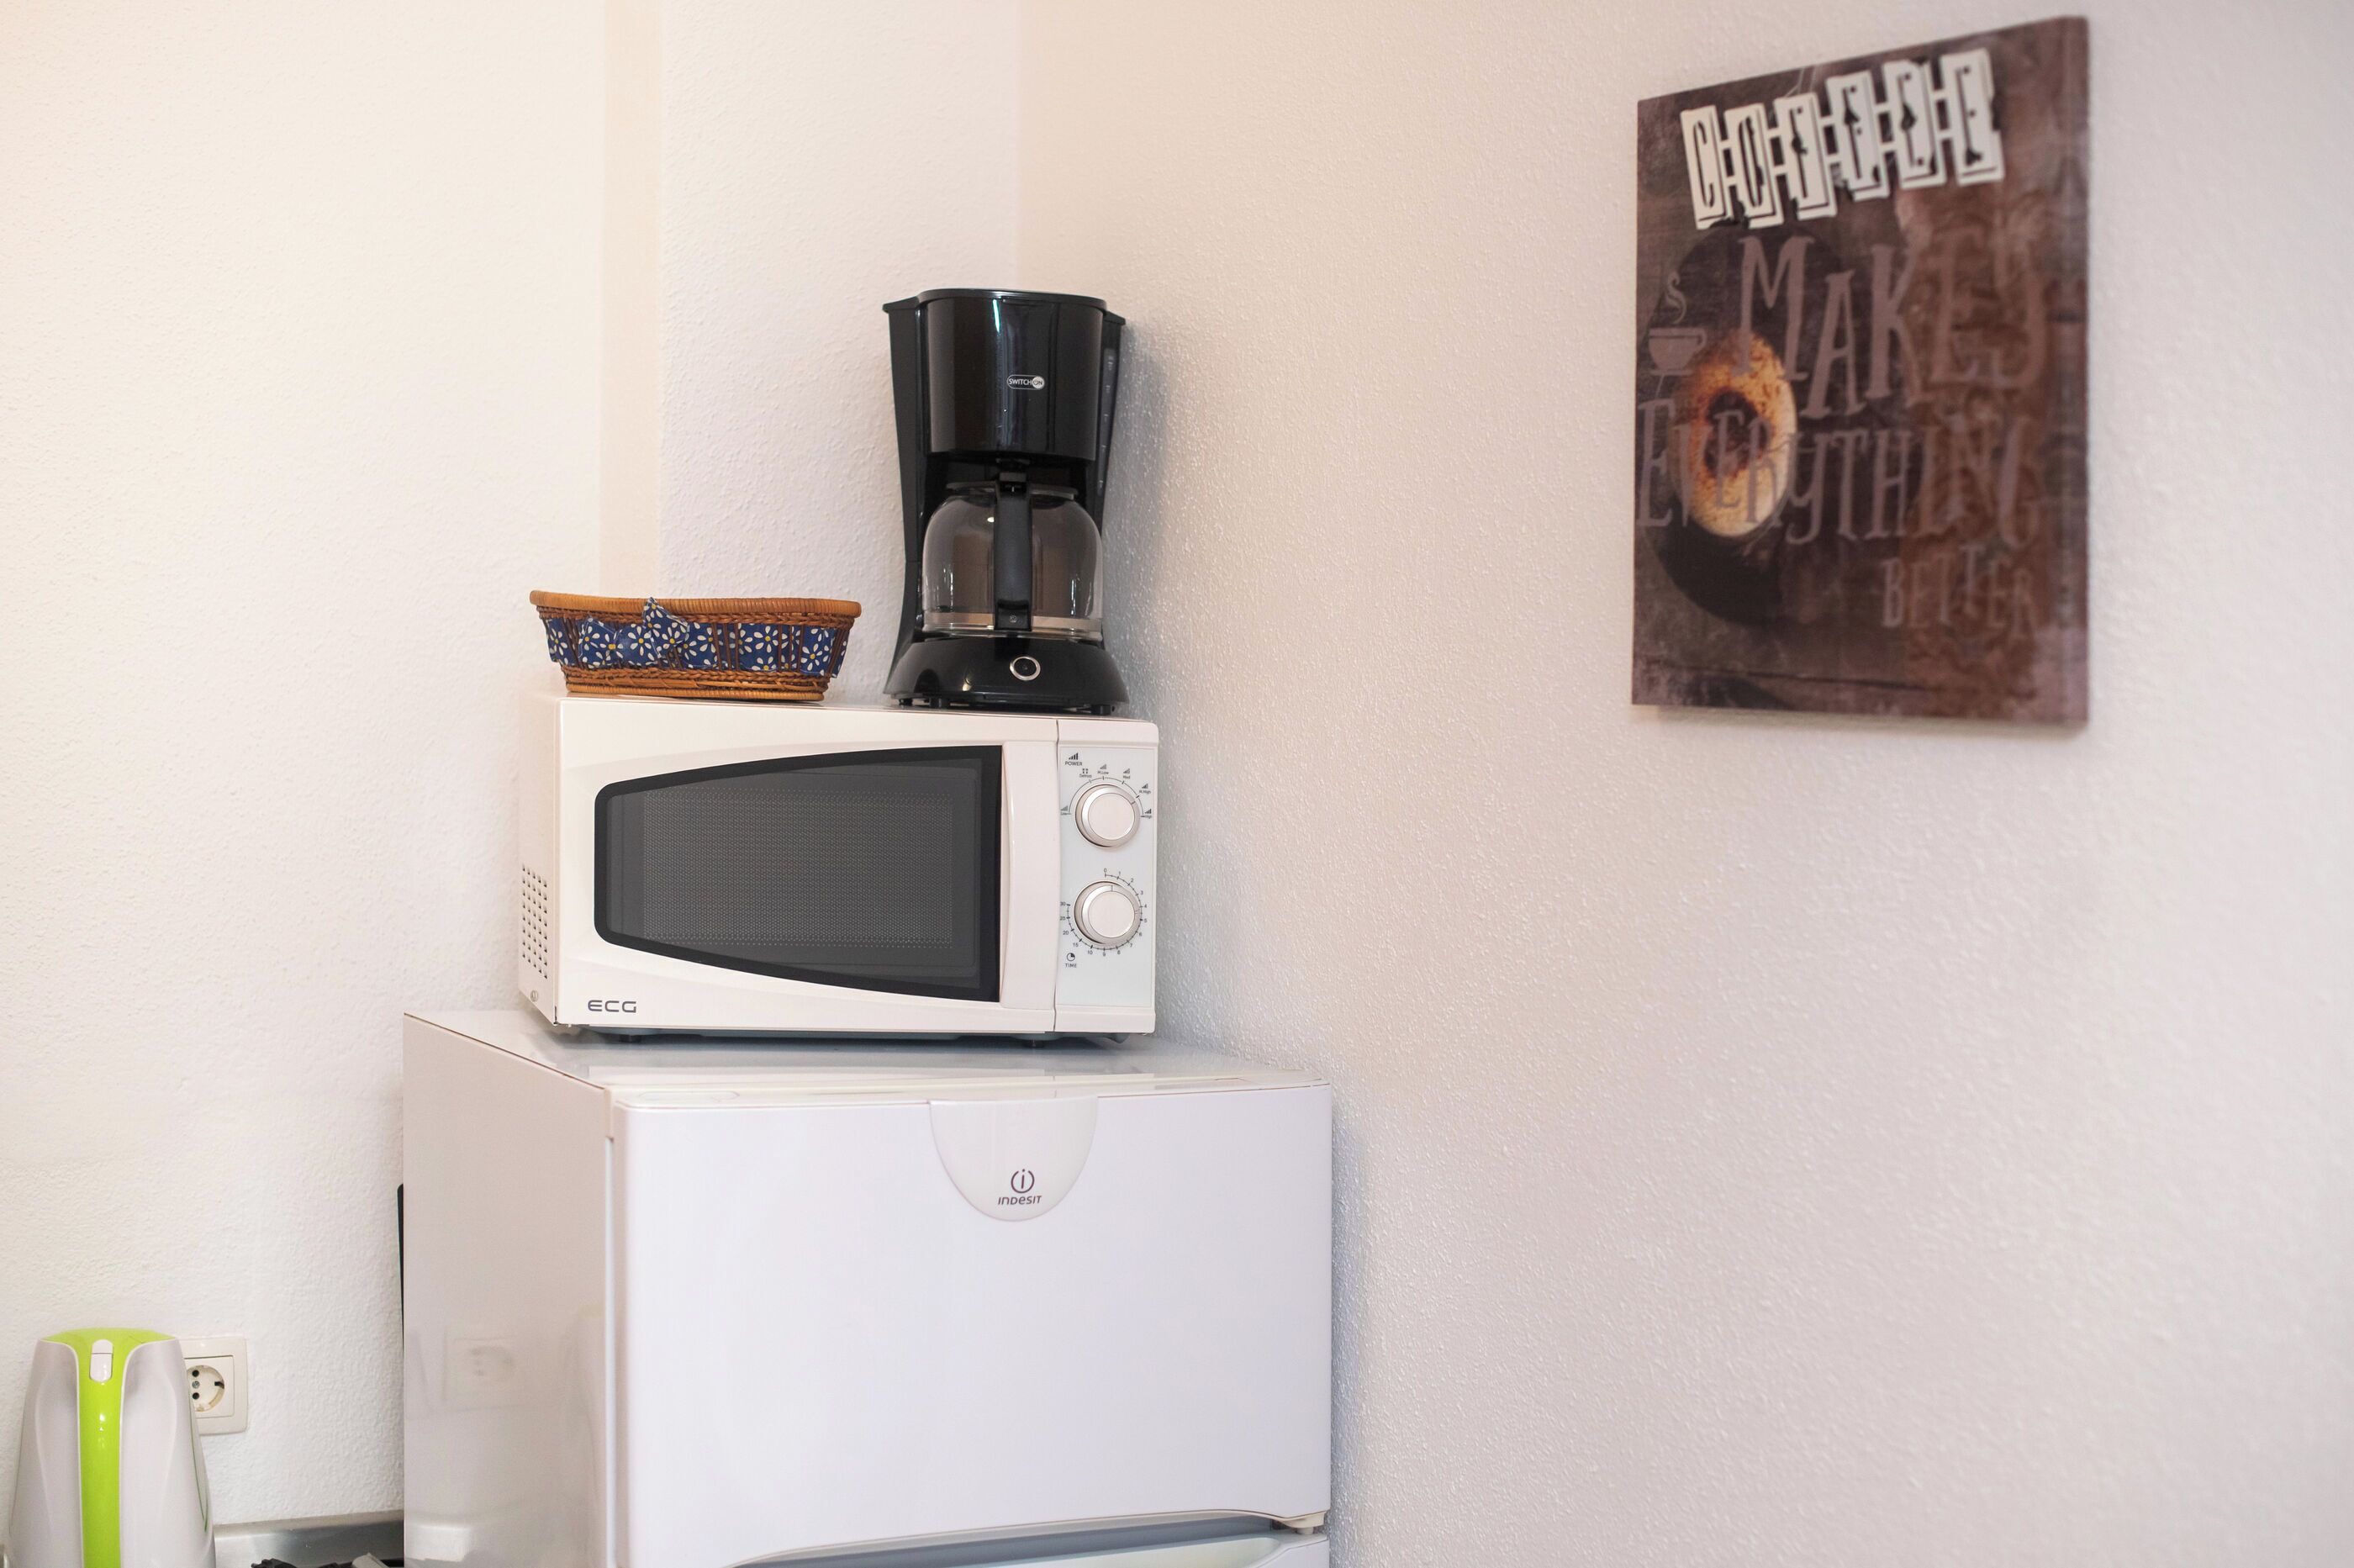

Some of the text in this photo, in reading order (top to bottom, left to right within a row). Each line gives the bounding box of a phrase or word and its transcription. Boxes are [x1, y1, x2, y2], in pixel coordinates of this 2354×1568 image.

[1736, 230, 2048, 419] MAKES
[1637, 399, 2040, 548] EVERYTHING
[588, 999, 637, 1014] ECG
